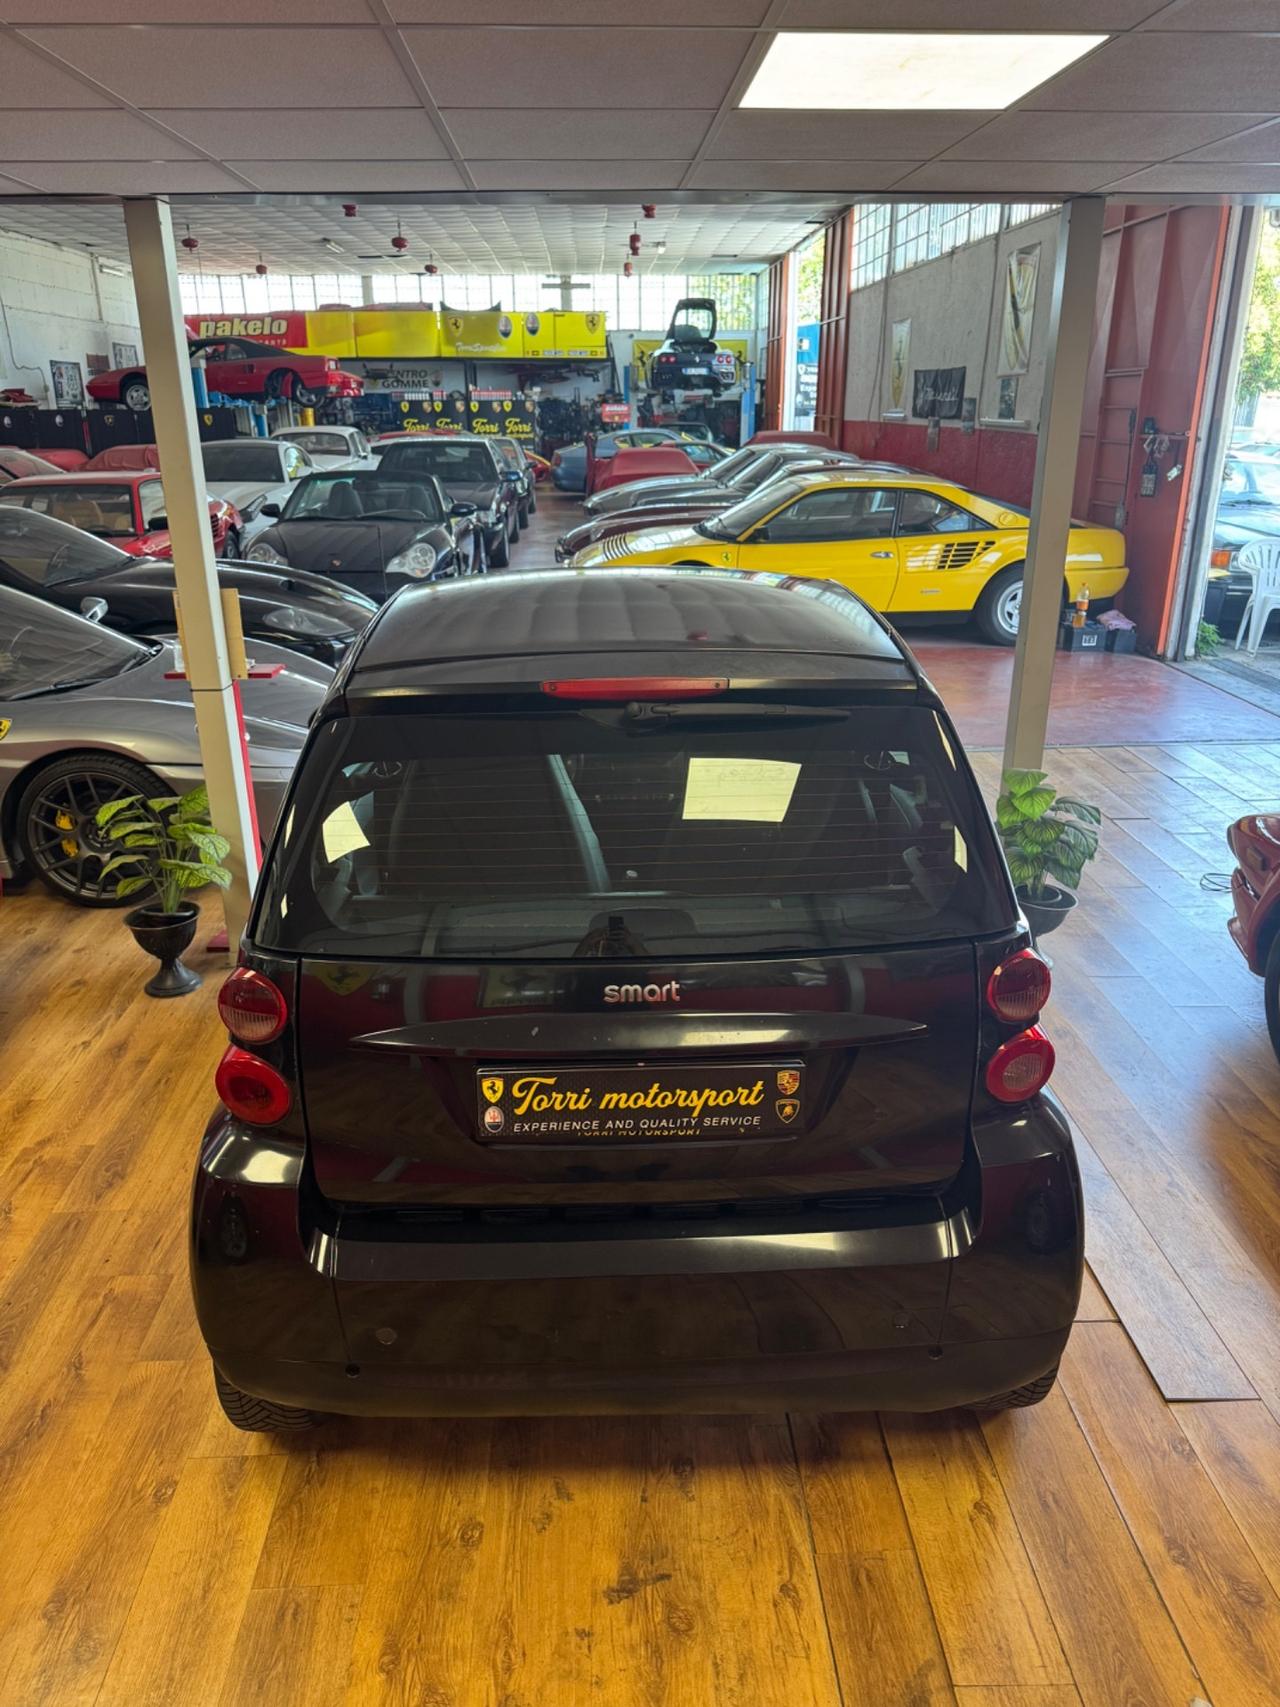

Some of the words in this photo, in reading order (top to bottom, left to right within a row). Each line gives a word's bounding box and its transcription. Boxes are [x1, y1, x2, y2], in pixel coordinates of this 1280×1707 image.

[199, 316, 288, 339] pakelo
[382, 379, 429, 388] GOMME
[472, 418, 499, 433] Torri
[505, 418, 532, 433] Torri
[604, 980, 681, 1003] smart
[512, 1076, 593, 1116] Torri
[599, 1080, 766, 1117] motorsport
[513, 1120, 600, 1133] EXPERIENCE
[605, 1119, 635, 1130] AND
[639, 1117, 700, 1129] QUALITY
[703, 1116, 762, 1127] SERVICE
